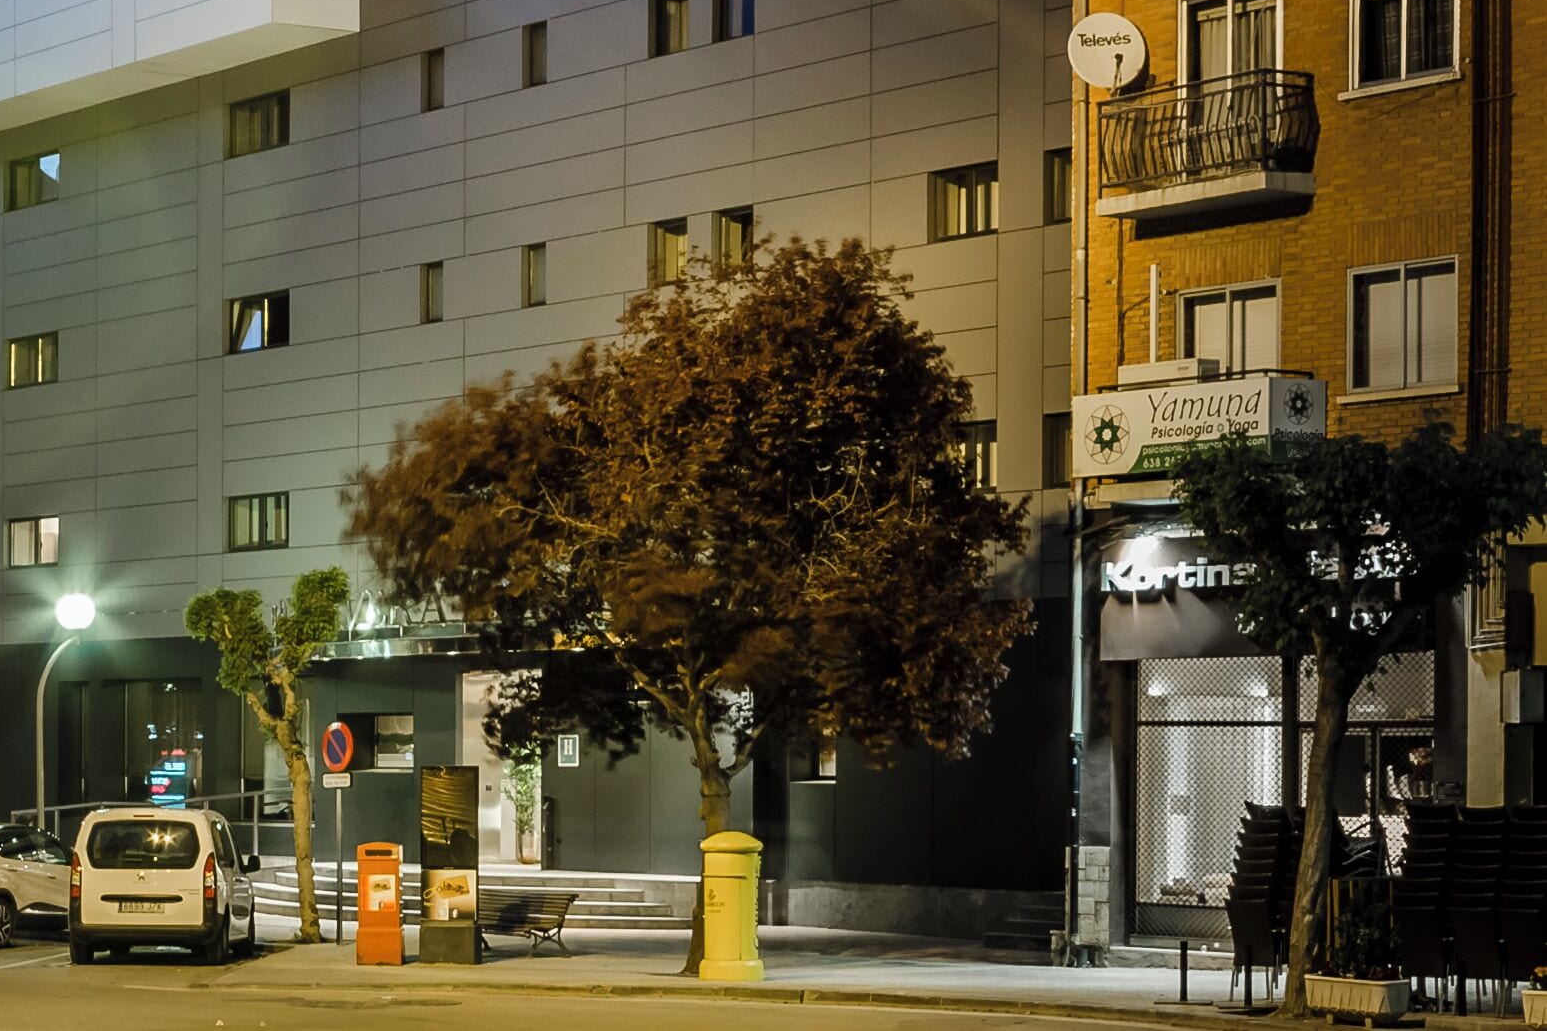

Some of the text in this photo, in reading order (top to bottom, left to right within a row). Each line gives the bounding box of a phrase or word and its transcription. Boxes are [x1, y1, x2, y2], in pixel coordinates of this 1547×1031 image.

[1077, 32, 1131, 47] Televés
[1148, 389, 1262, 423] Yamuna
[1151, 419, 1259, 440] Psicología Yoga
[564, 739, 573, 755] H
